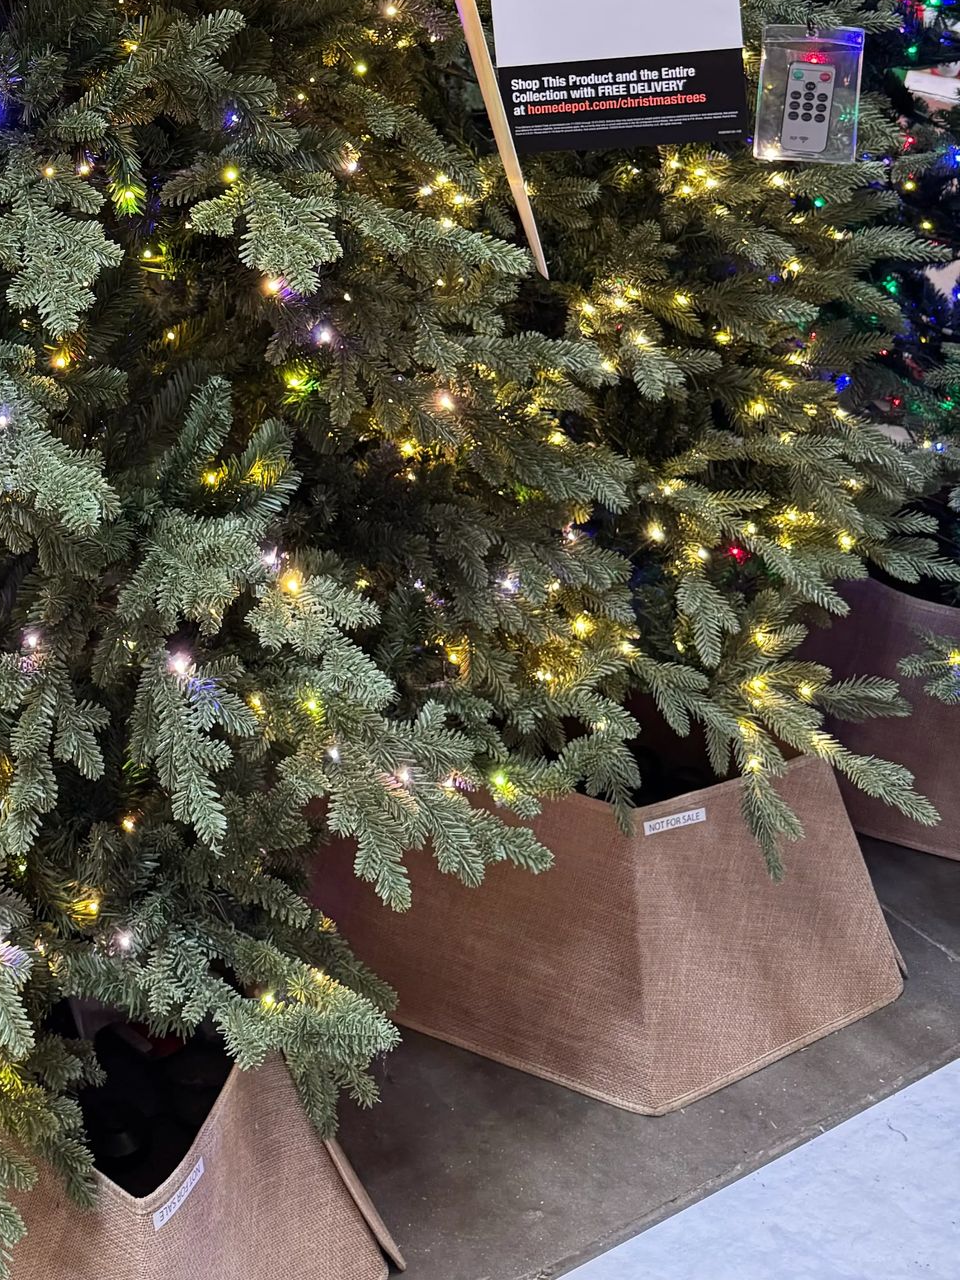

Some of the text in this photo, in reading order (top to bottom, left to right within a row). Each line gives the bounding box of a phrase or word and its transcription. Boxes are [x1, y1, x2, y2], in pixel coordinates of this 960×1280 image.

[510, 66, 696, 91] Shop This Product and the Entire
[512, 89, 568, 103] Collection
[570, 86, 595, 99] with
[598, 84, 627, 97] FREE
[513, 93, 707, 116] at homedepot.com/christmastrees
[648, 811, 701, 832] NOT FOR SALE
[159, 1164, 201, 1222] NOT FOR SALE
